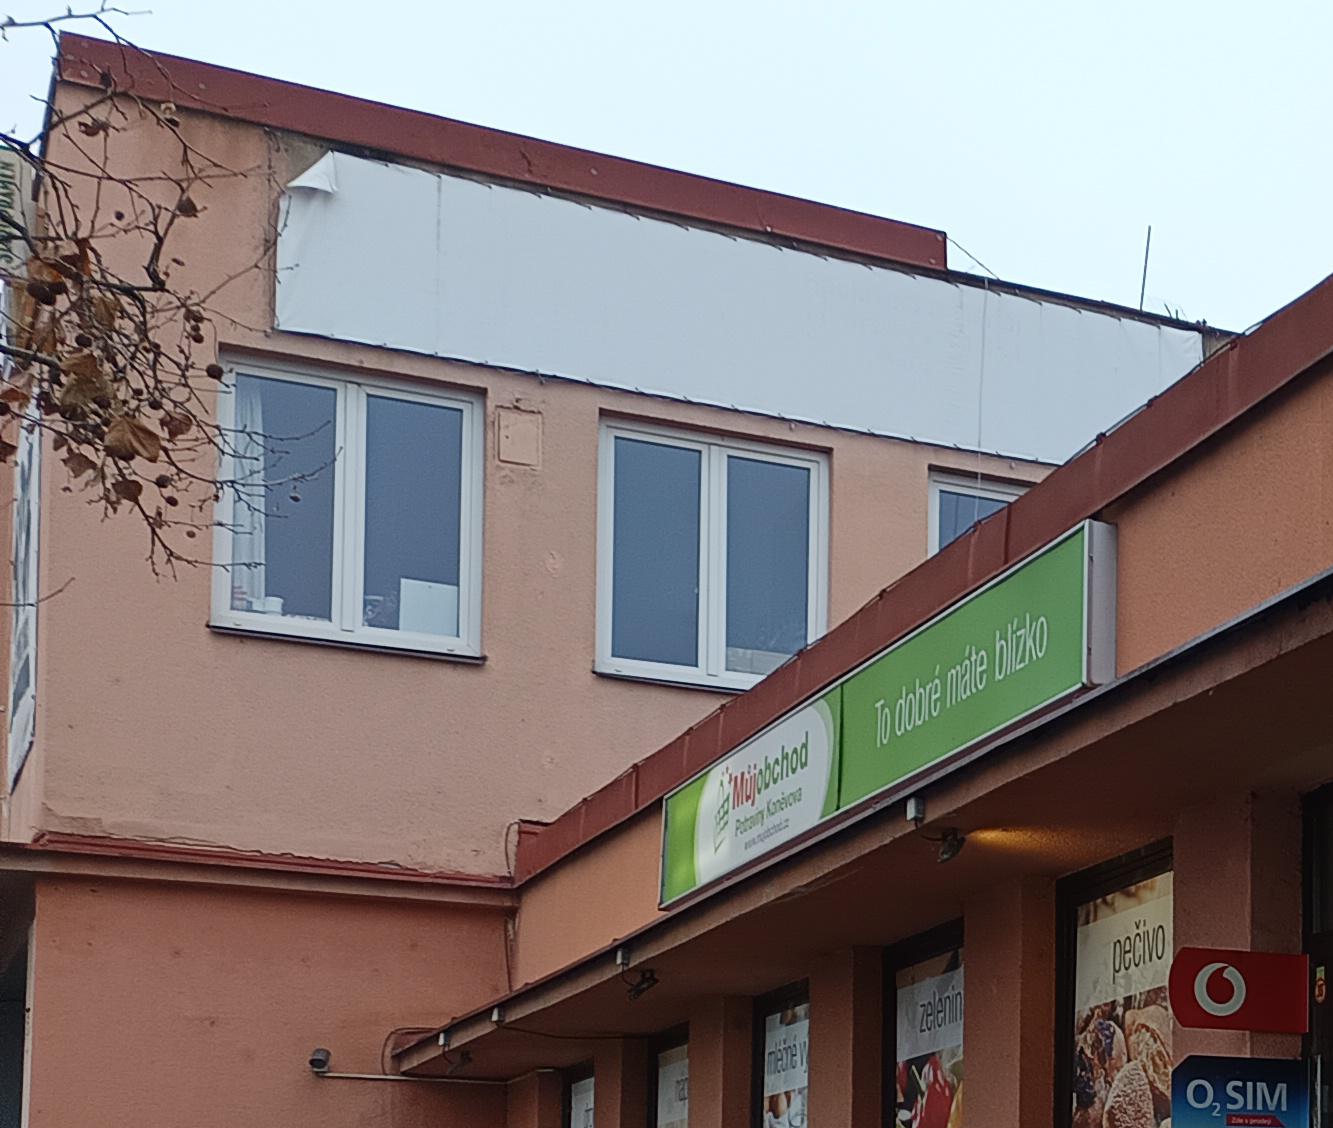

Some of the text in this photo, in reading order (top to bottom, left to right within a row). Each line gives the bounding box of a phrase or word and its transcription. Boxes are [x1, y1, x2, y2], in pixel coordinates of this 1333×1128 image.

[874, 612, 1048, 748] To dobré máte blízko
[1112, 920, 1165, 984] pečivo
[1225, 1080, 1288, 1112] SIM
